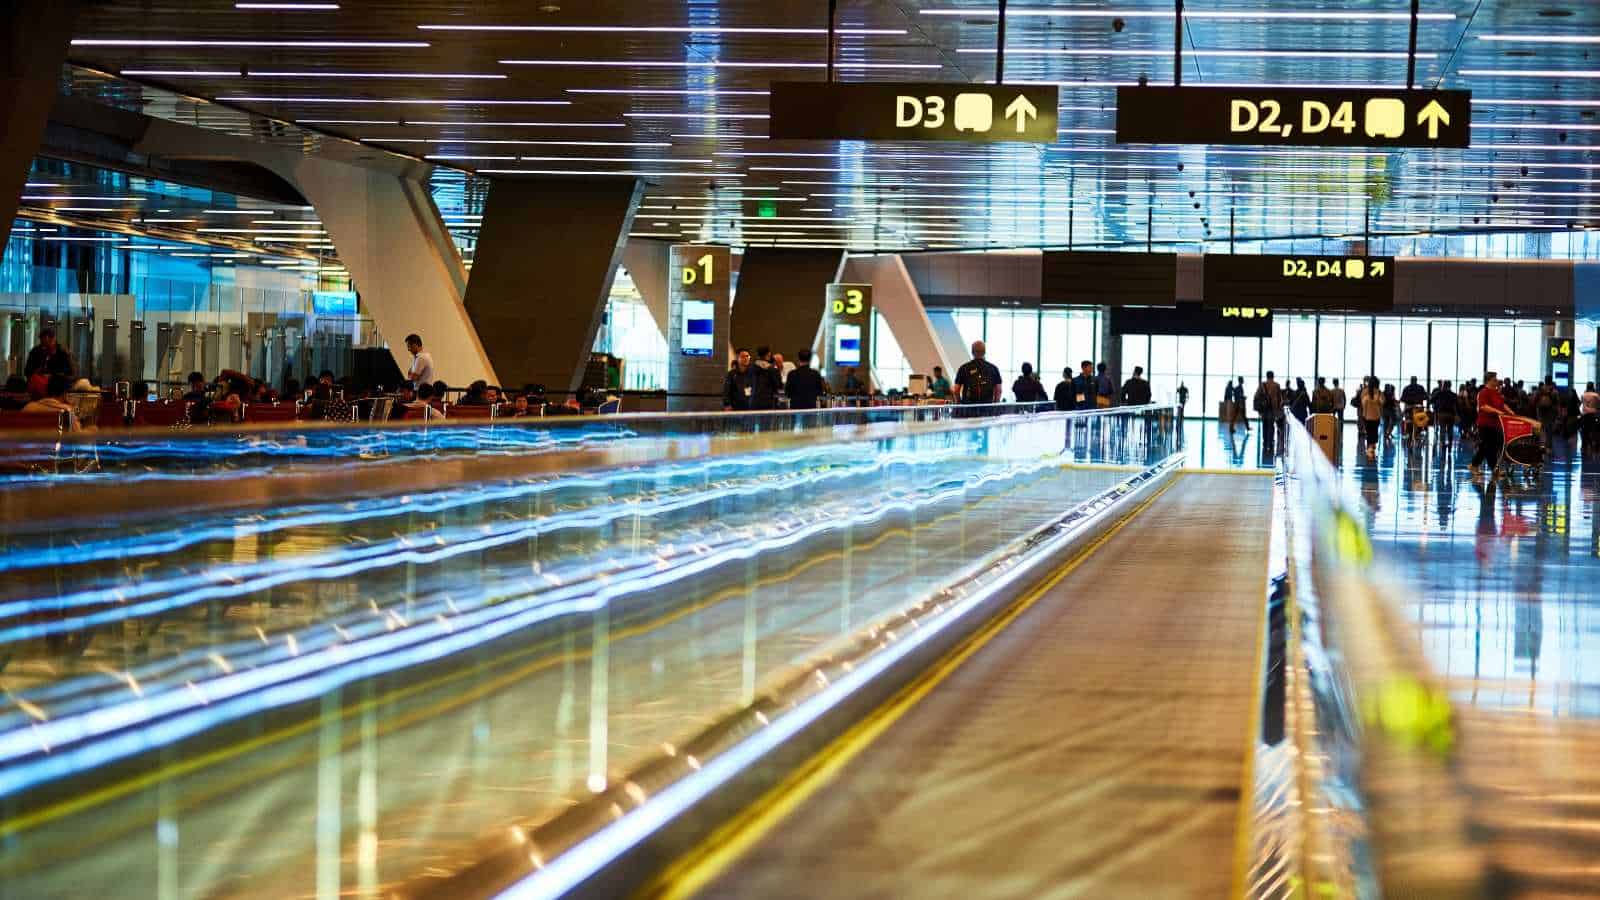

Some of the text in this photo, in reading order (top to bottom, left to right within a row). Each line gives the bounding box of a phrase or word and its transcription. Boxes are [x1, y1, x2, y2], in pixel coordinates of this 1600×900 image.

[895, 95, 945, 129] D3
[1230, 99, 1356, 138] D2, D4
[1283, 259, 1342, 279] D2, D4
